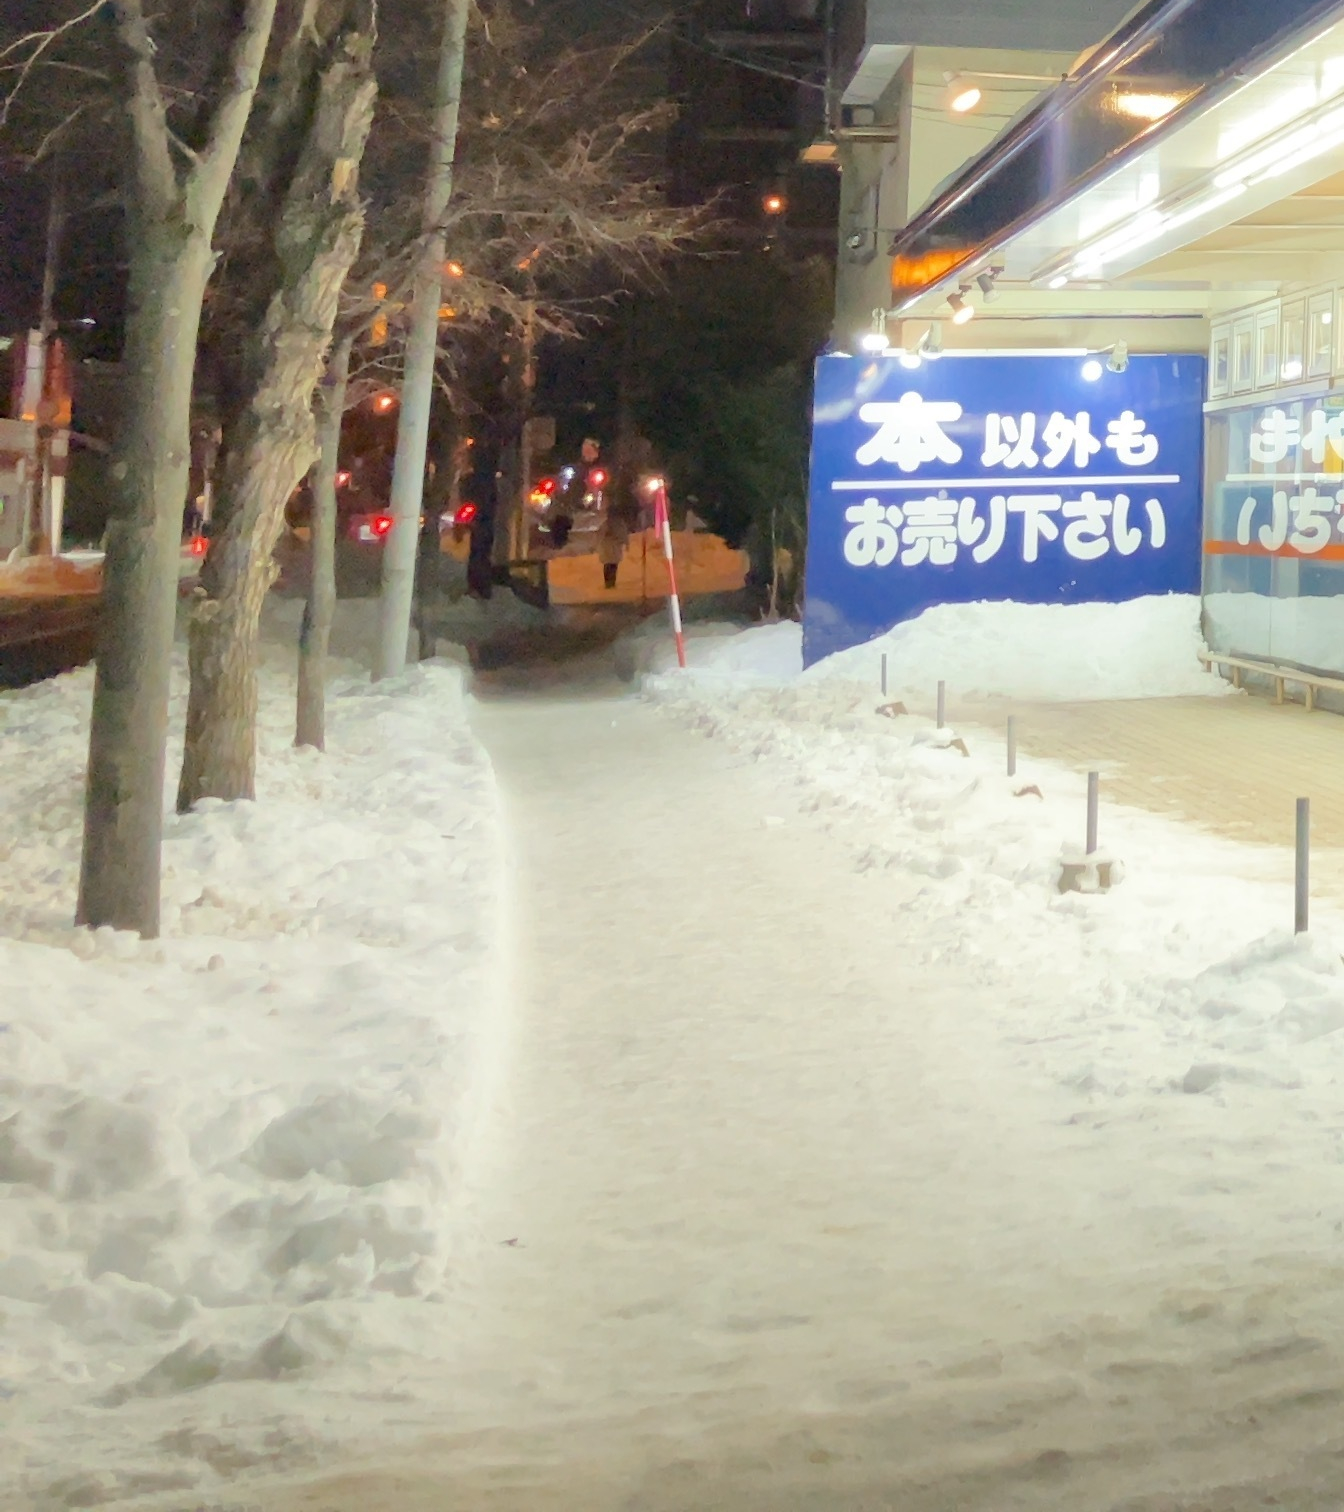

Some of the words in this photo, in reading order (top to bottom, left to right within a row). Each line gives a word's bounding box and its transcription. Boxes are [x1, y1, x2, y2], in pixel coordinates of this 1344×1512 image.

[843, 491, 1167, 567] お売り下さい
